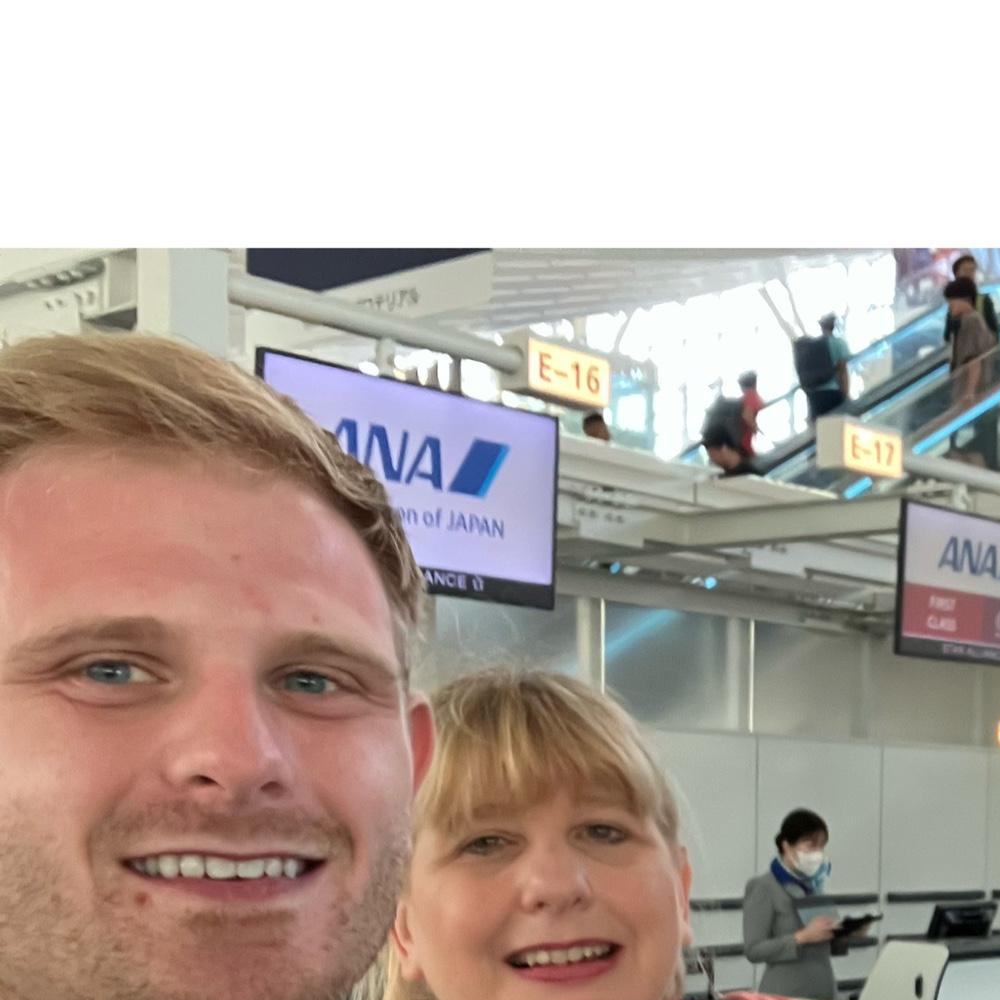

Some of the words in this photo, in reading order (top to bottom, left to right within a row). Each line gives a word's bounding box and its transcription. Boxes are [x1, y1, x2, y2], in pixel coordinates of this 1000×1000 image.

[537, 352, 601, 395] E-16
[334, 418, 442, 491] ANA
[851, 433, 895, 468] E-17
[423, 508, 442, 529] of
[446, 510, 505, 539] JAPAN
[938, 536, 999, 580] ANA
